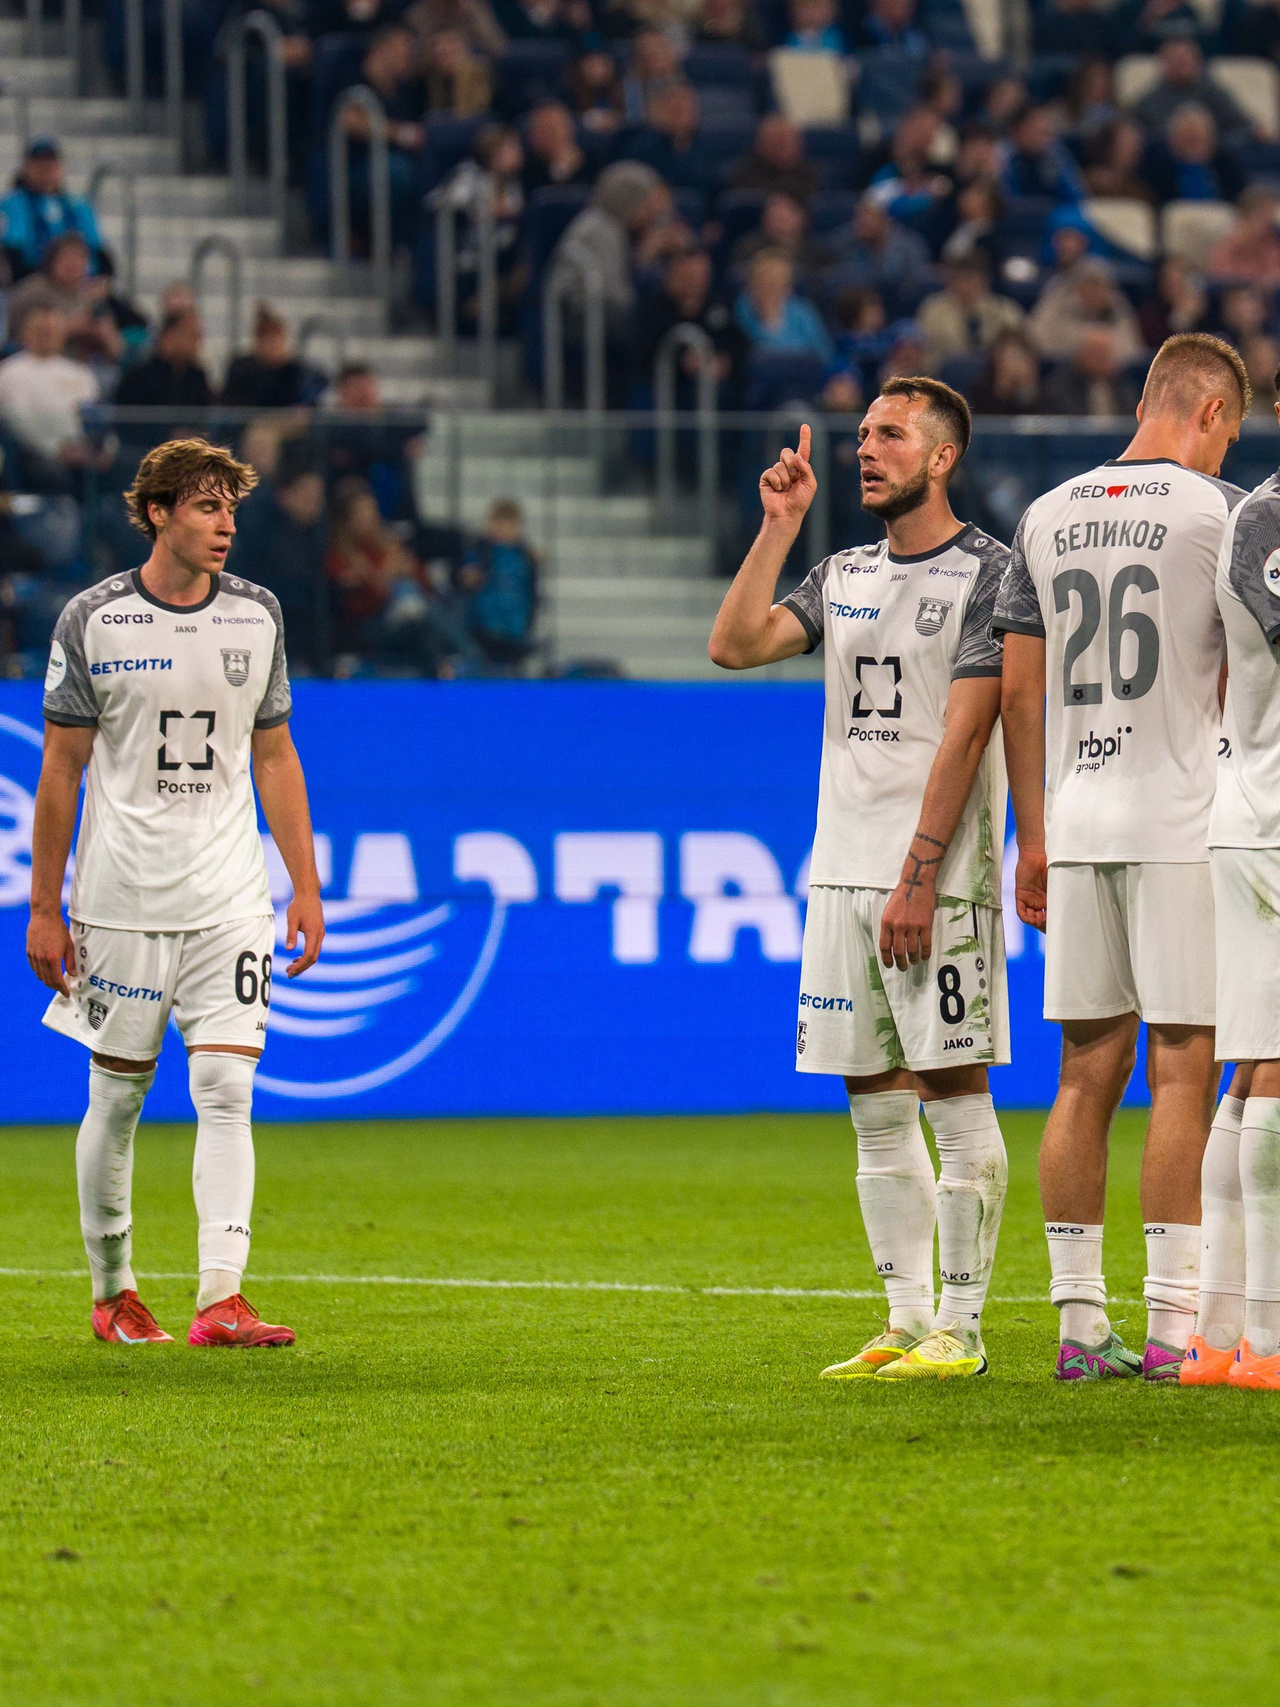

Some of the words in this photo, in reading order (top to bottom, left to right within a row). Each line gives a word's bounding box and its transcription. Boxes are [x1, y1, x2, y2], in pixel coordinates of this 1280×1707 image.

[1054, 519, 1168, 557] БЕЛИКОВ
[889, 573, 908, 582] JAKO
[174, 625, 198, 633] JAKO
[1052, 564, 1160, 707] 26
[89, 658, 173, 676] БЕТСИТИ
[847, 726, 900, 742] Ростех
[1075, 762, 1101, 774] group
[157, 779, 212, 794] Ростех
[235, 950, 272, 1008] 68
[88, 974, 163, 1002] БЕТСИТИ
[937, 964, 966, 1025] 8
[942, 1037, 974, 1050] JAKO
